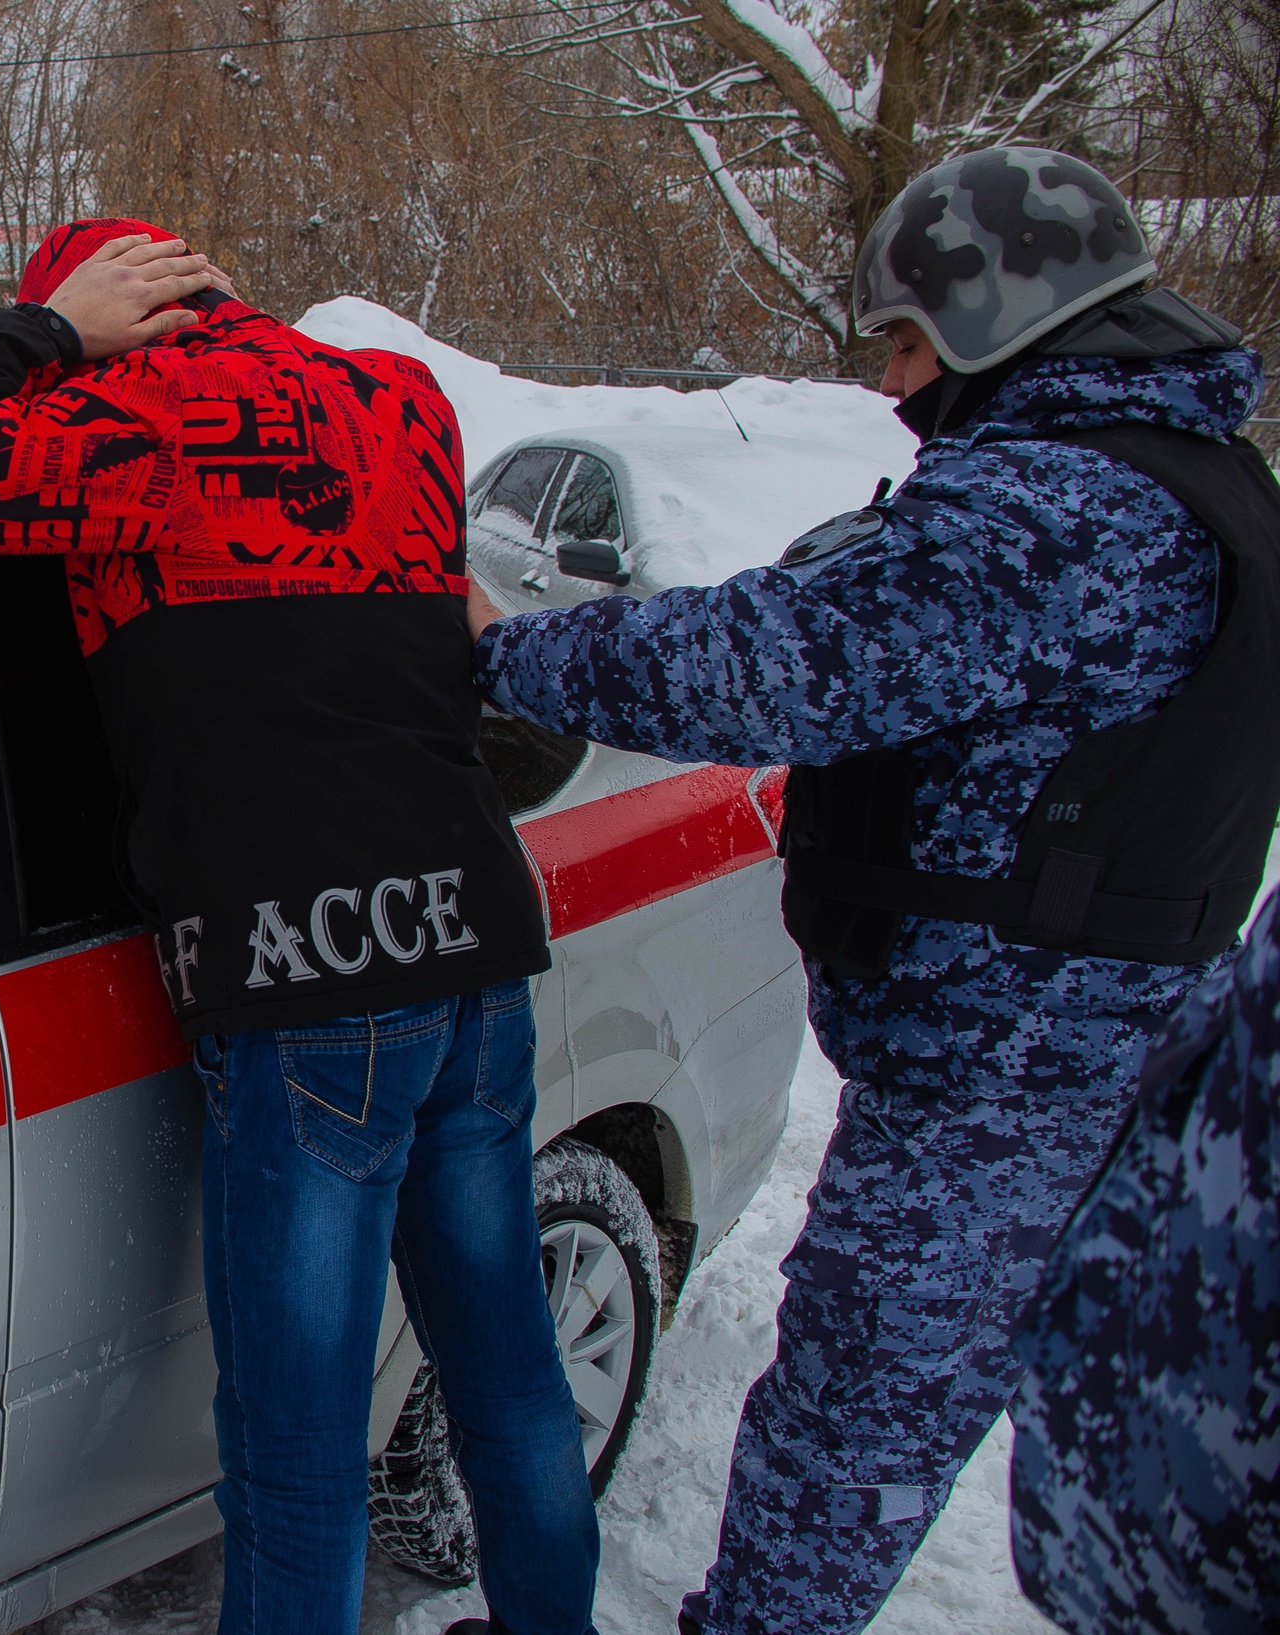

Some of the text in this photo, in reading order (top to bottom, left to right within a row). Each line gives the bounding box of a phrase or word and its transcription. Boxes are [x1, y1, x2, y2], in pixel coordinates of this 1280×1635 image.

[138, 435, 176, 509] СУВОРО
[175, 576, 270, 597] СУВОРОВСКИЙ
[245, 868, 480, 988] ACCE
